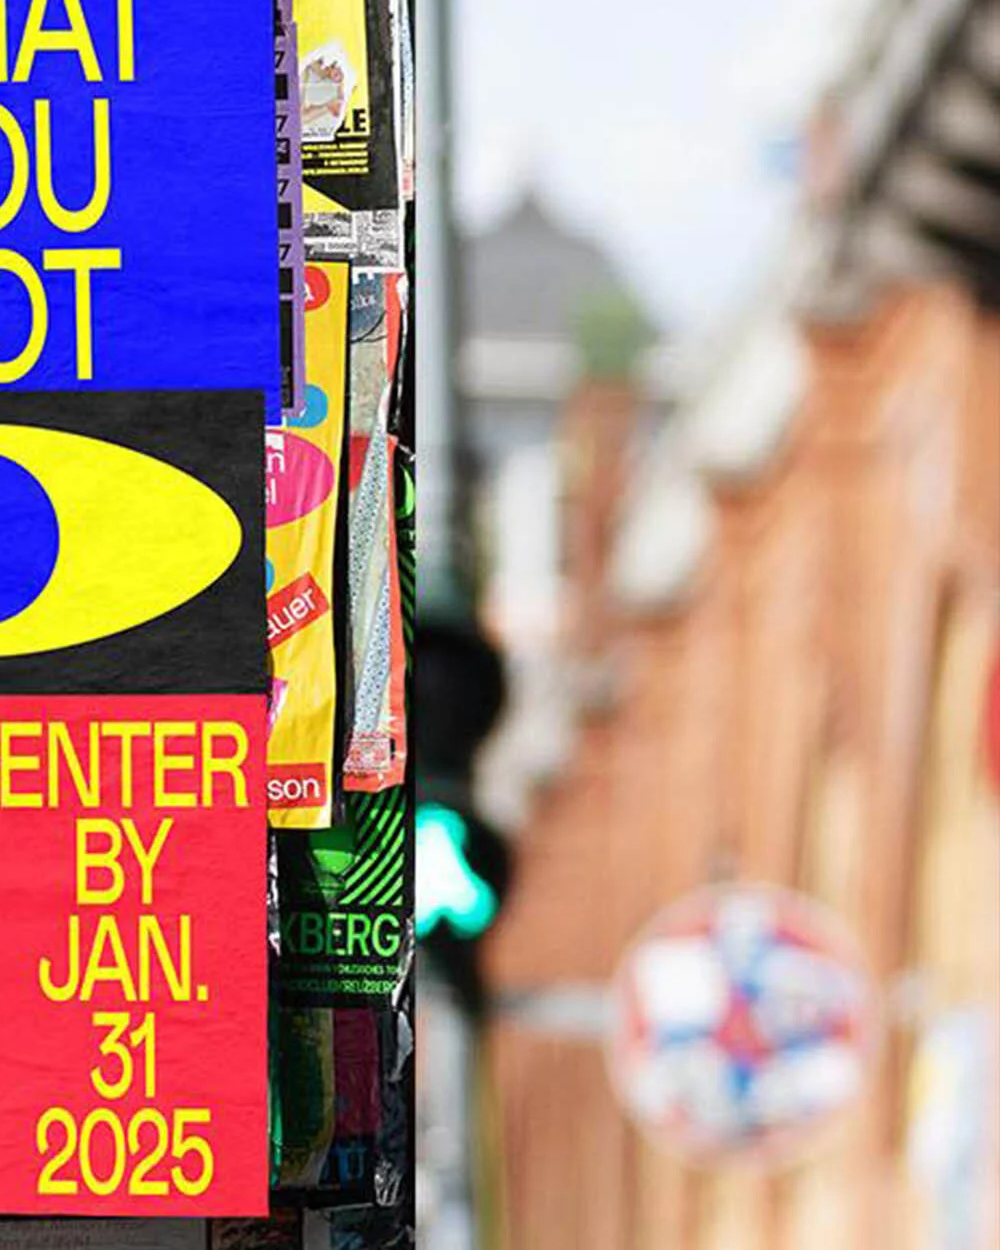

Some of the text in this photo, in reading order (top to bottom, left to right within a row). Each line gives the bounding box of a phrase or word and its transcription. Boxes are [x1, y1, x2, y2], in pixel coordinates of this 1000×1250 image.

[0, 721, 249, 808] ENTER
[76, 817, 174, 905] BY
[39, 914, 208, 1002] JAN.
[90, 1011, 155, 1099] 31
[36, 1107, 214, 1196] 2025
